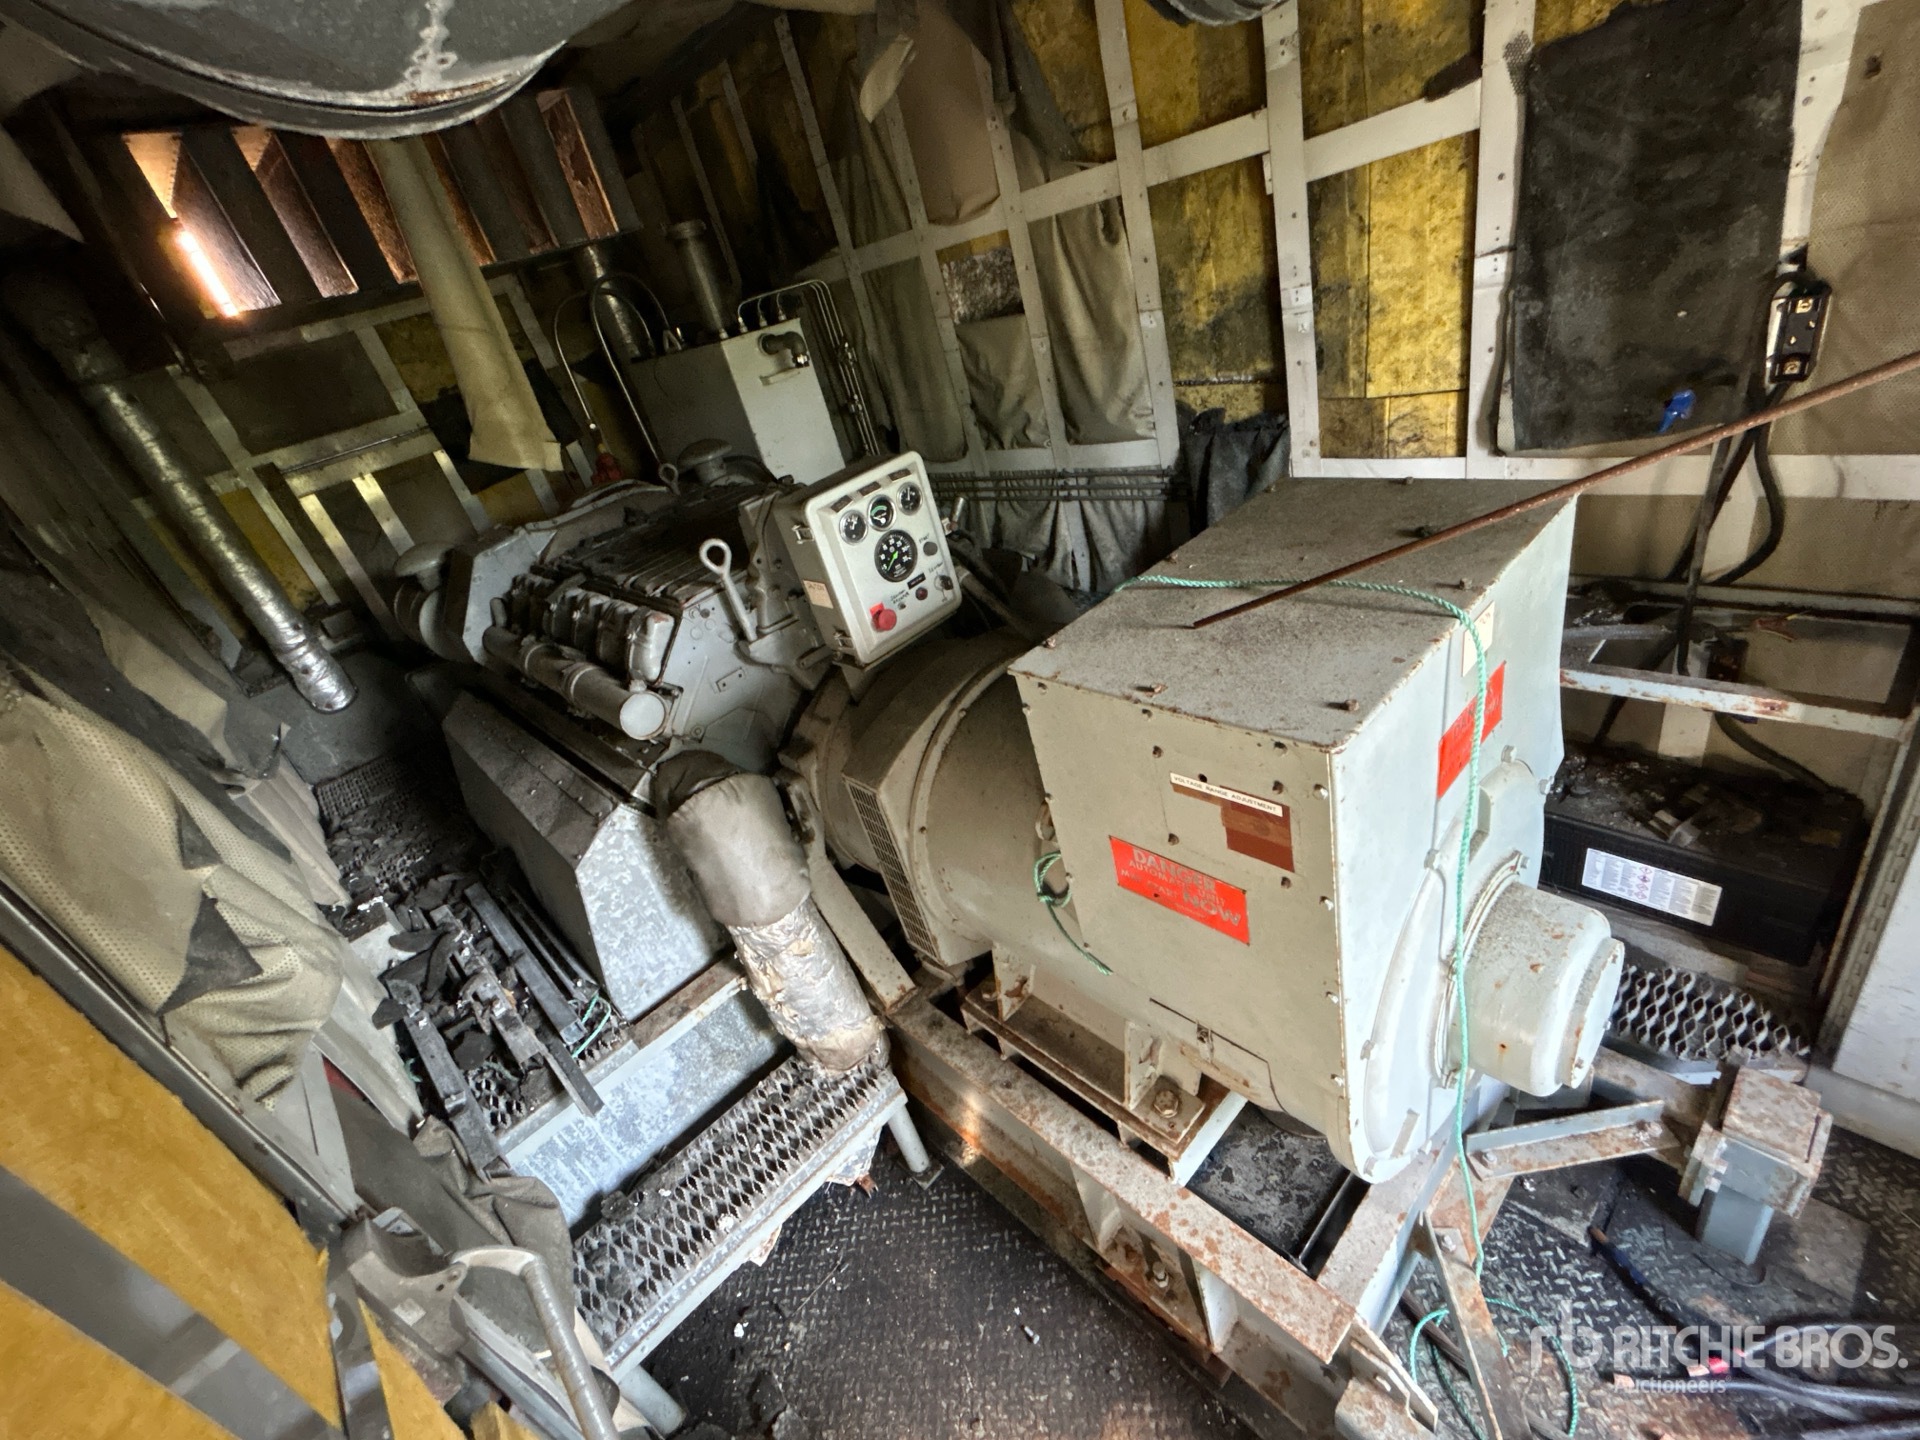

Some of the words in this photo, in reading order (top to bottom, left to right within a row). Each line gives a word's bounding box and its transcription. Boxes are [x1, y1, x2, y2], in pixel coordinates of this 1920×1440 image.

[1173, 776, 1202, 789] VOLTAGE
[1205, 785, 1227, 796] RANGE
[1231, 793, 1276, 812] ADJUSTMENT
[1133, 848, 1216, 891] DANGER
[1183, 889, 1241, 926] NOW
